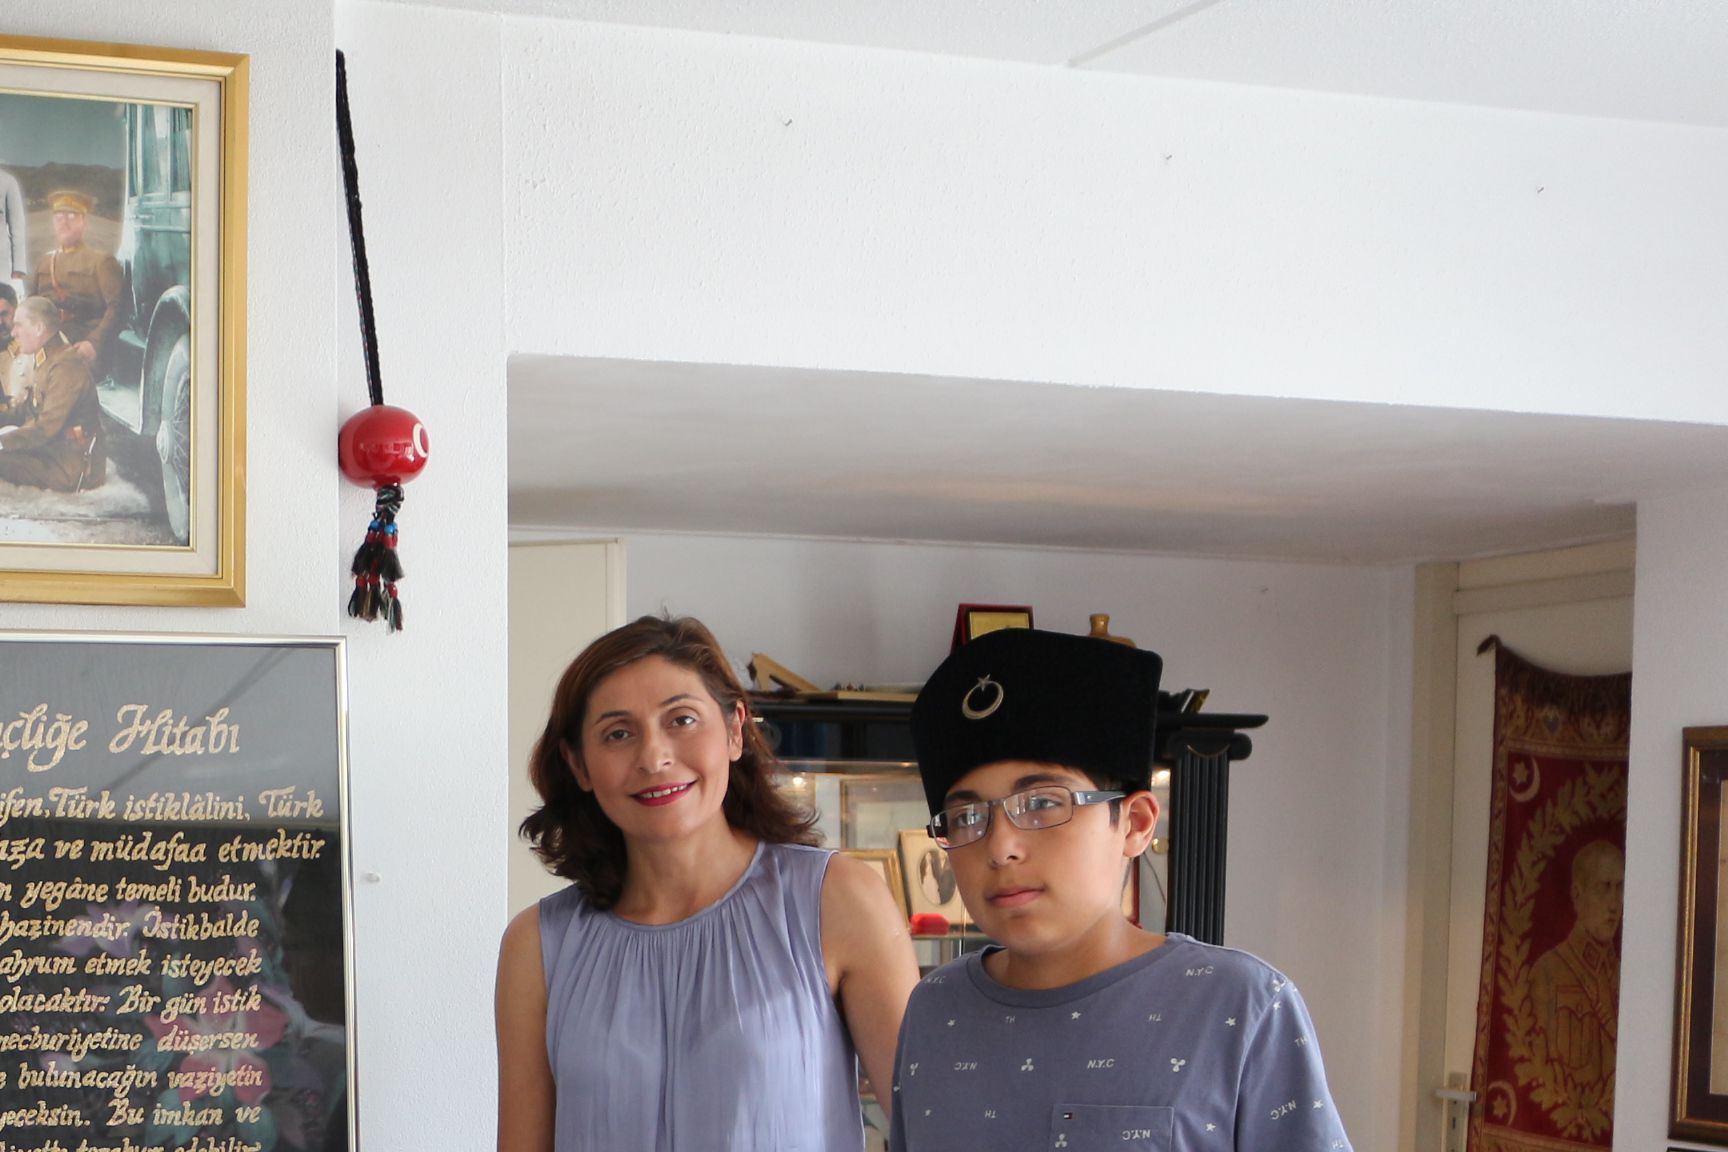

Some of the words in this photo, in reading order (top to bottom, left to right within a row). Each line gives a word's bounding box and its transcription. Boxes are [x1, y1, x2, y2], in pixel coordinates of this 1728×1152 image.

[109, 704, 239, 755] Hitabı
[49, 787, 115, 819] Türk
[259, 786, 323, 818] Türk
[53, 838, 85, 860] ve
[90, 831, 207, 871] müdafaa
[19, 876, 109, 912] yegâne
[115, 875, 182, 903] temeli
[84, 946, 152, 976] etmek
[161, 948, 262, 986] isteyecek
[115, 984, 162, 1015] Bir
[160, 993, 207, 1024] gün
[213, 984, 262, 1014] istik
[157, 1025, 259, 1055] düşersen
[167, 1065, 263, 1097] vaziyetin
[1087, 1058, 1115, 1070] N.Y.C
[105, 1097, 144, 1126] Bu
[153, 1100, 223, 1126] imkan
